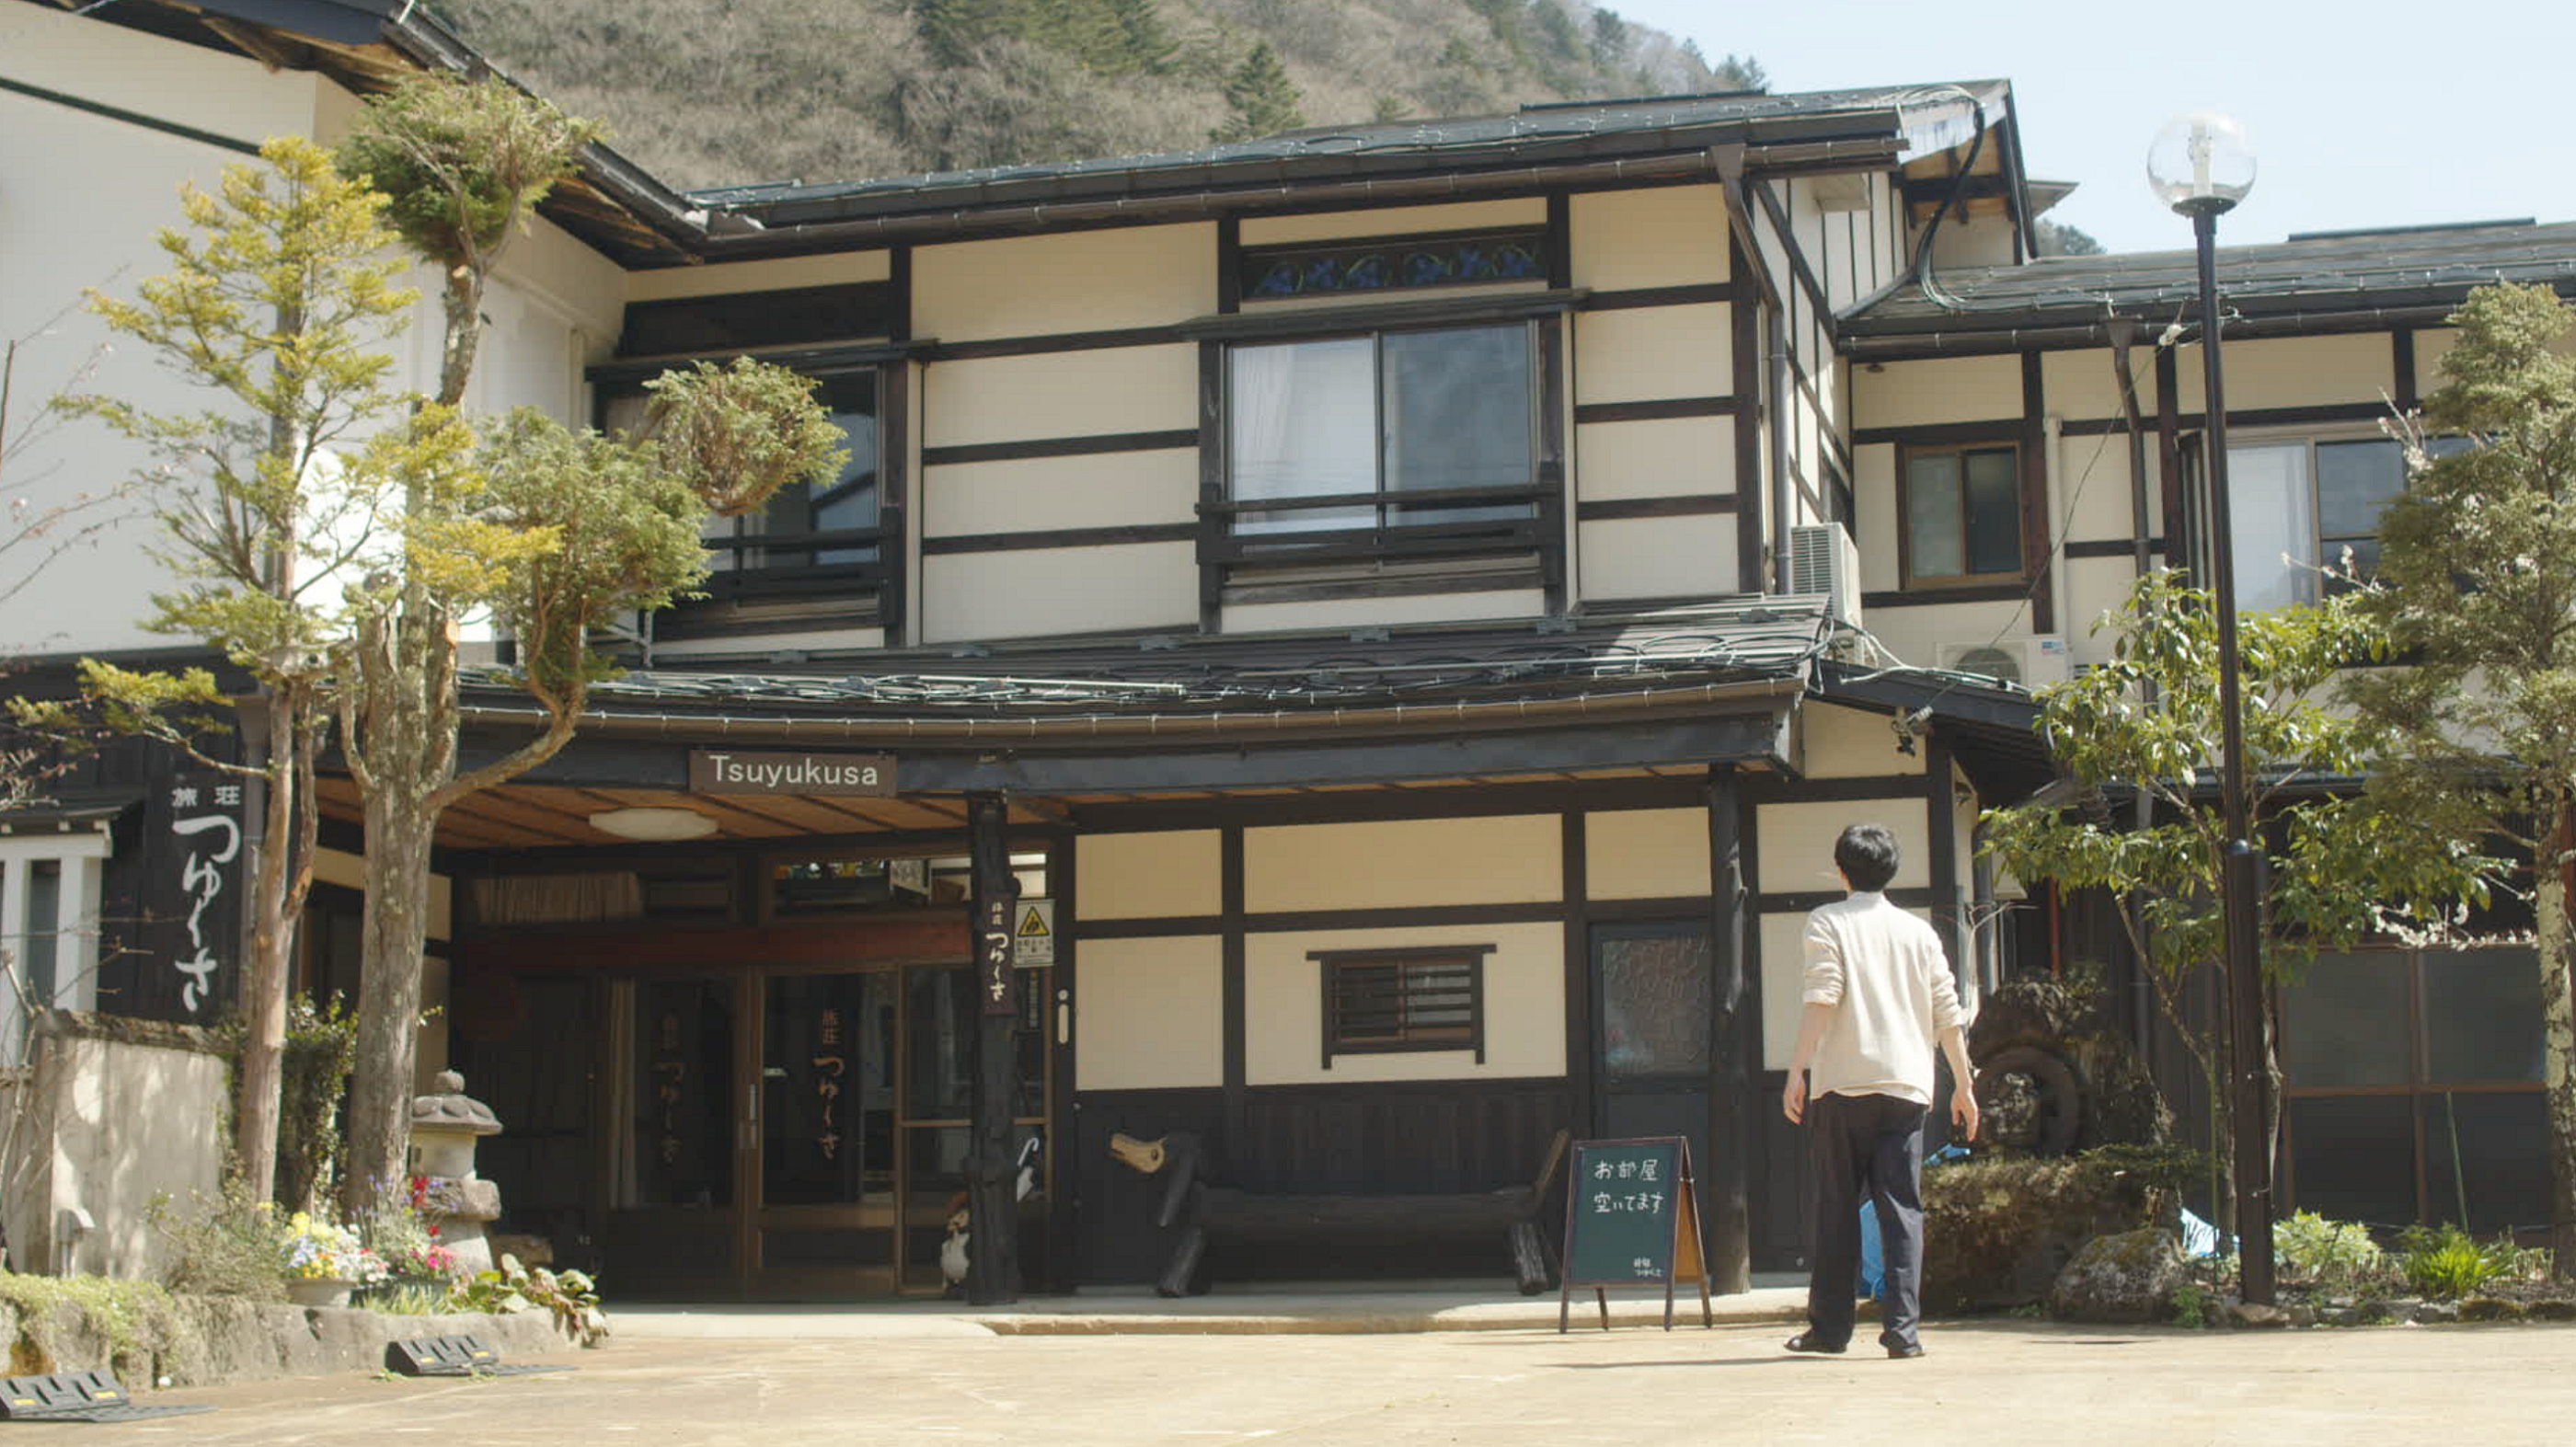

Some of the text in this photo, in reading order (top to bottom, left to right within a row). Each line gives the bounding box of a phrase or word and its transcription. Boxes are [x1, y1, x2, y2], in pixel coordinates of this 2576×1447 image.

[708, 754, 878, 788] Tsuyukusa
[171, 786, 241, 807] 旅荘
[172, 814, 241, 1012] つゆくさ
[1593, 1158, 1659, 1182] お部屋
[1593, 1191, 1664, 1214] 空いてます
